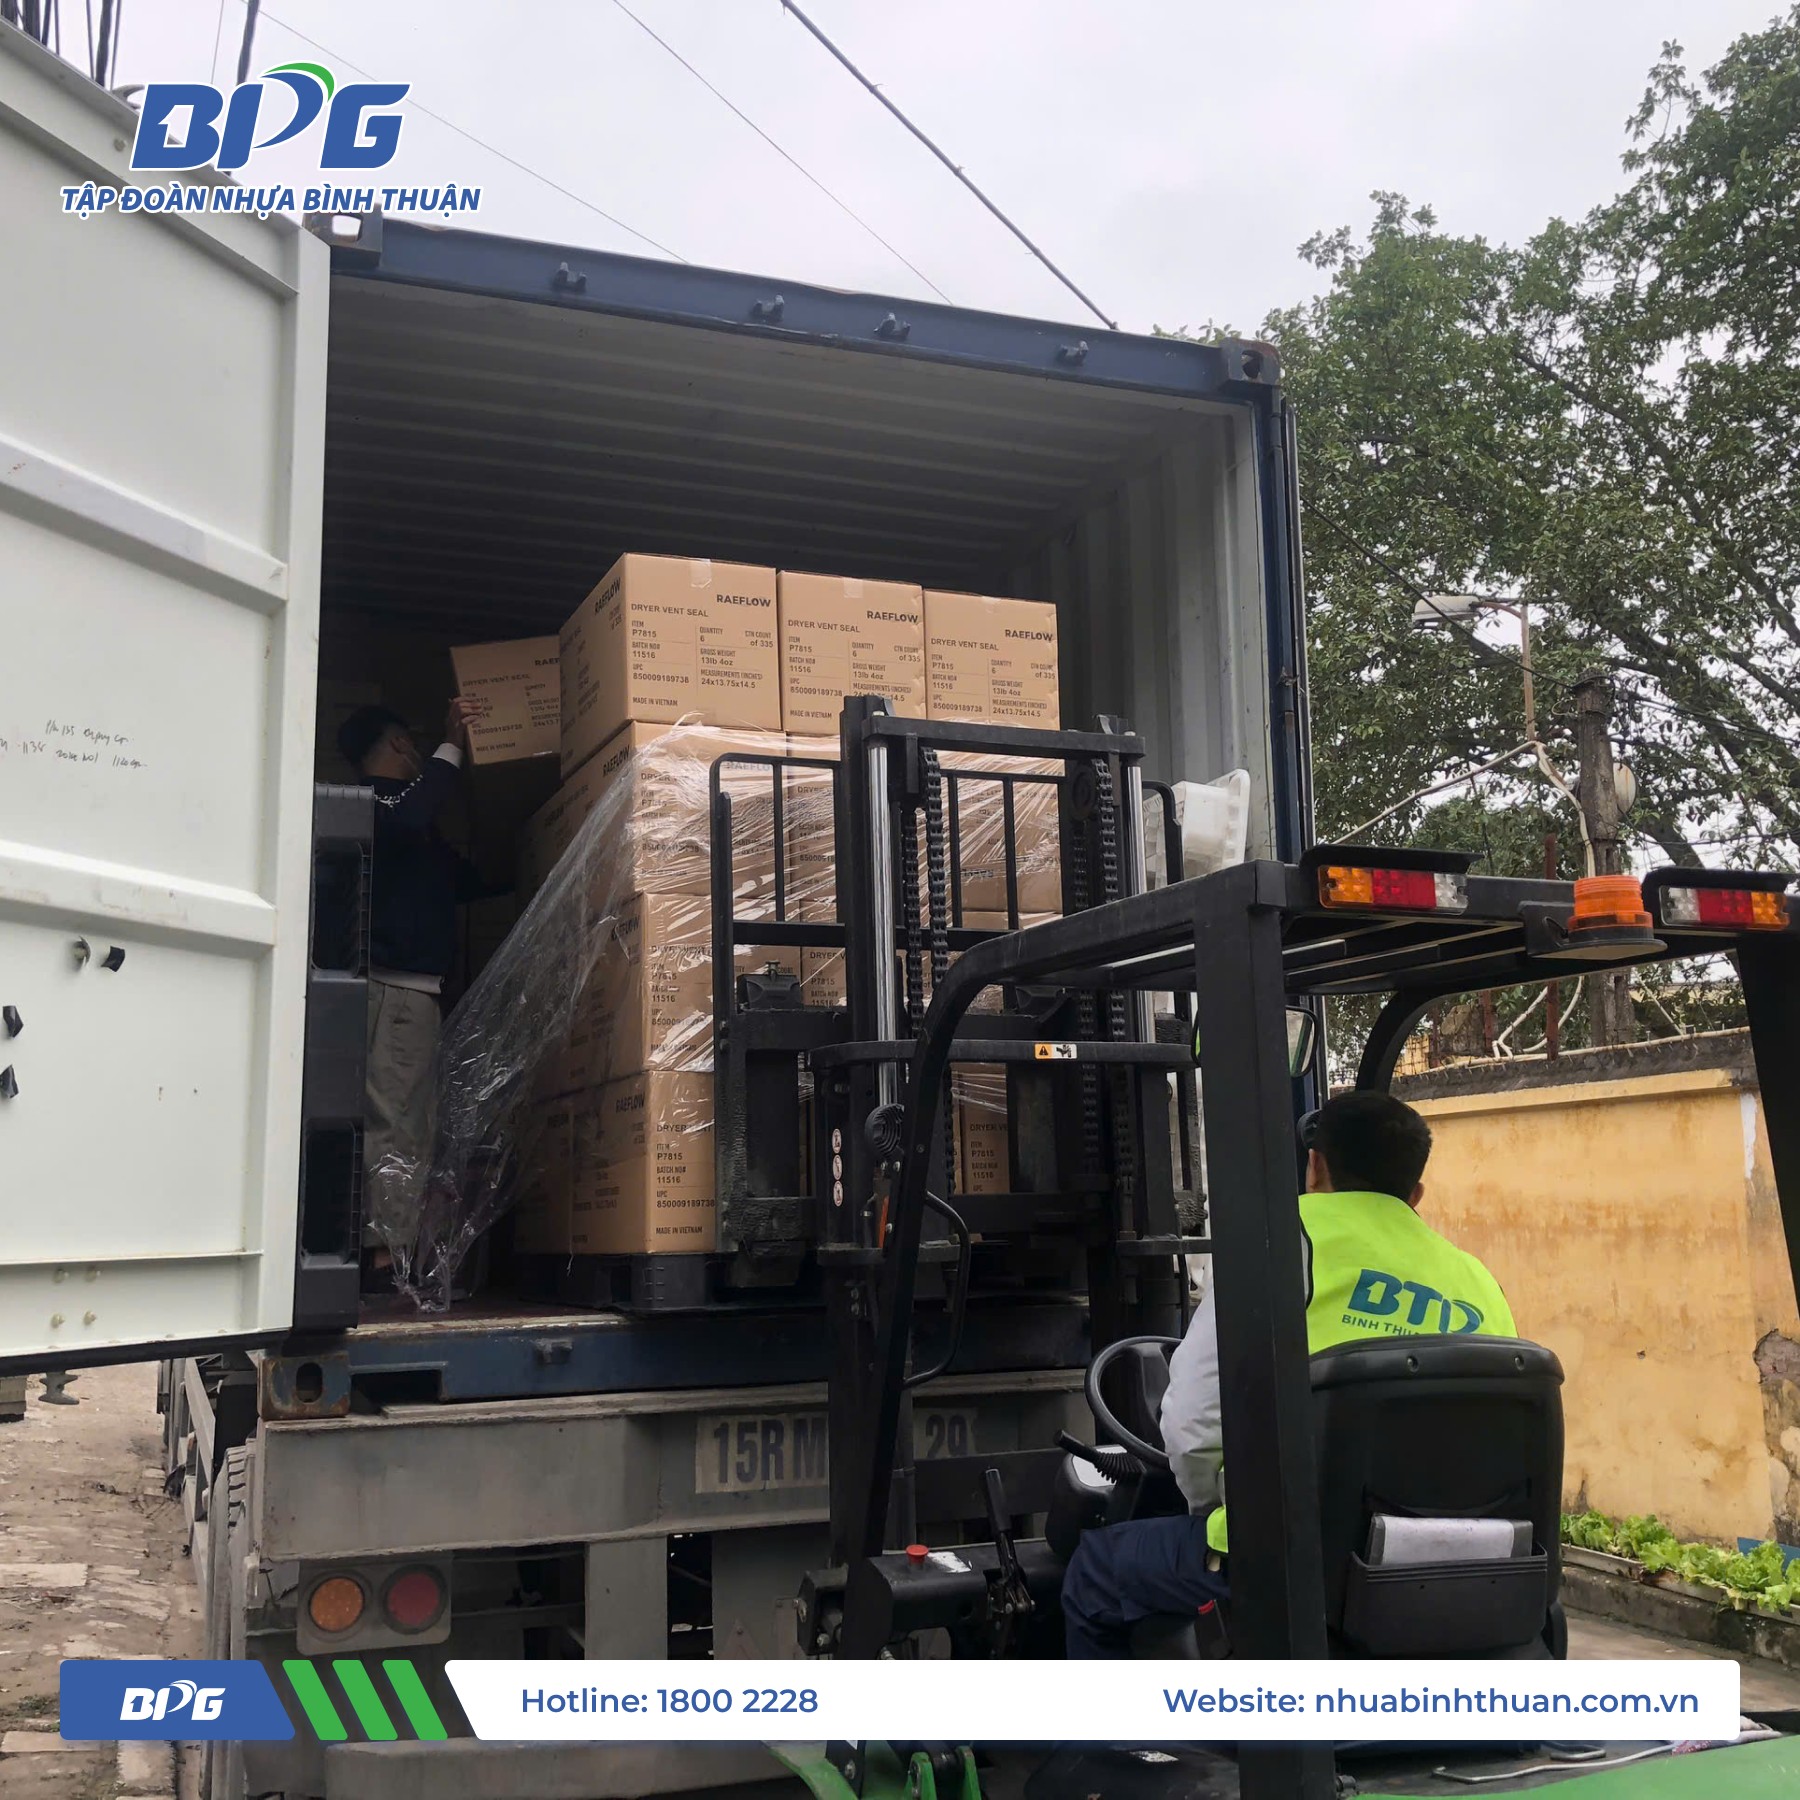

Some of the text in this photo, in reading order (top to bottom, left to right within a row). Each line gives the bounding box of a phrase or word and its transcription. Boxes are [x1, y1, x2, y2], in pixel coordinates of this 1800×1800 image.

[716, 594, 771, 607] RAEFLOW
[631, 603, 709, 617] DRYER VENT SEAL
[866, 610, 919, 623] RAEFLOW
[788, 619, 861, 633] DRYER VENT SEAL
[632, 629, 657, 638] P7815
[700, 627, 723, 635] QUANTITY
[756, 631, 771, 639] COUNT
[1005, 629, 1053, 643] RAEFLOW
[632, 641, 648, 649] BATCH
[760, 640, 774, 648] 335
[852, 641, 874, 650] QUANTITY
[931, 638, 999, 651] DRYER VENT SEAL
[700, 648, 735, 657] GROSS WEIGHT
[789, 645, 812, 653] P7815
[632, 651, 656, 659] 11516
[701, 657, 733, 666] 13lb 4oz
[932, 662, 954, 670] P7815
[632, 663, 643, 671] UPC
[790, 665, 811, 673] 11516
[633, 672, 690, 683] 850009189738
[701, 669, 740, 679] MEASUREMENTS
[853, 671, 884, 680] 13lb 4oz
[1043, 672, 1056, 680] 335
[701, 678, 756, 689] 24x13.75x14.5
[933, 681, 953, 690] 11516
[790, 686, 843, 697] 850009189738
[993, 687, 1007, 696] 13lb
[655, 698, 678, 706] VIETNAM
[790, 710, 804, 718] MADE
[811, 711, 832, 719] VIETNAM
[811, 978, 835, 986] P7815
[657, 1152, 683, 1160] P7815
[657, 1166, 674, 1174] BATCH
[657, 1176, 681, 1184] 11516
[657, 1190, 668, 1198] UPC
[657, 1199, 715, 1208] 850009189738
[656, 1227, 670, 1235] MADE
[679, 1226, 703, 1234] VIETNAM
[1341, 1314, 1380, 1331] BINH
